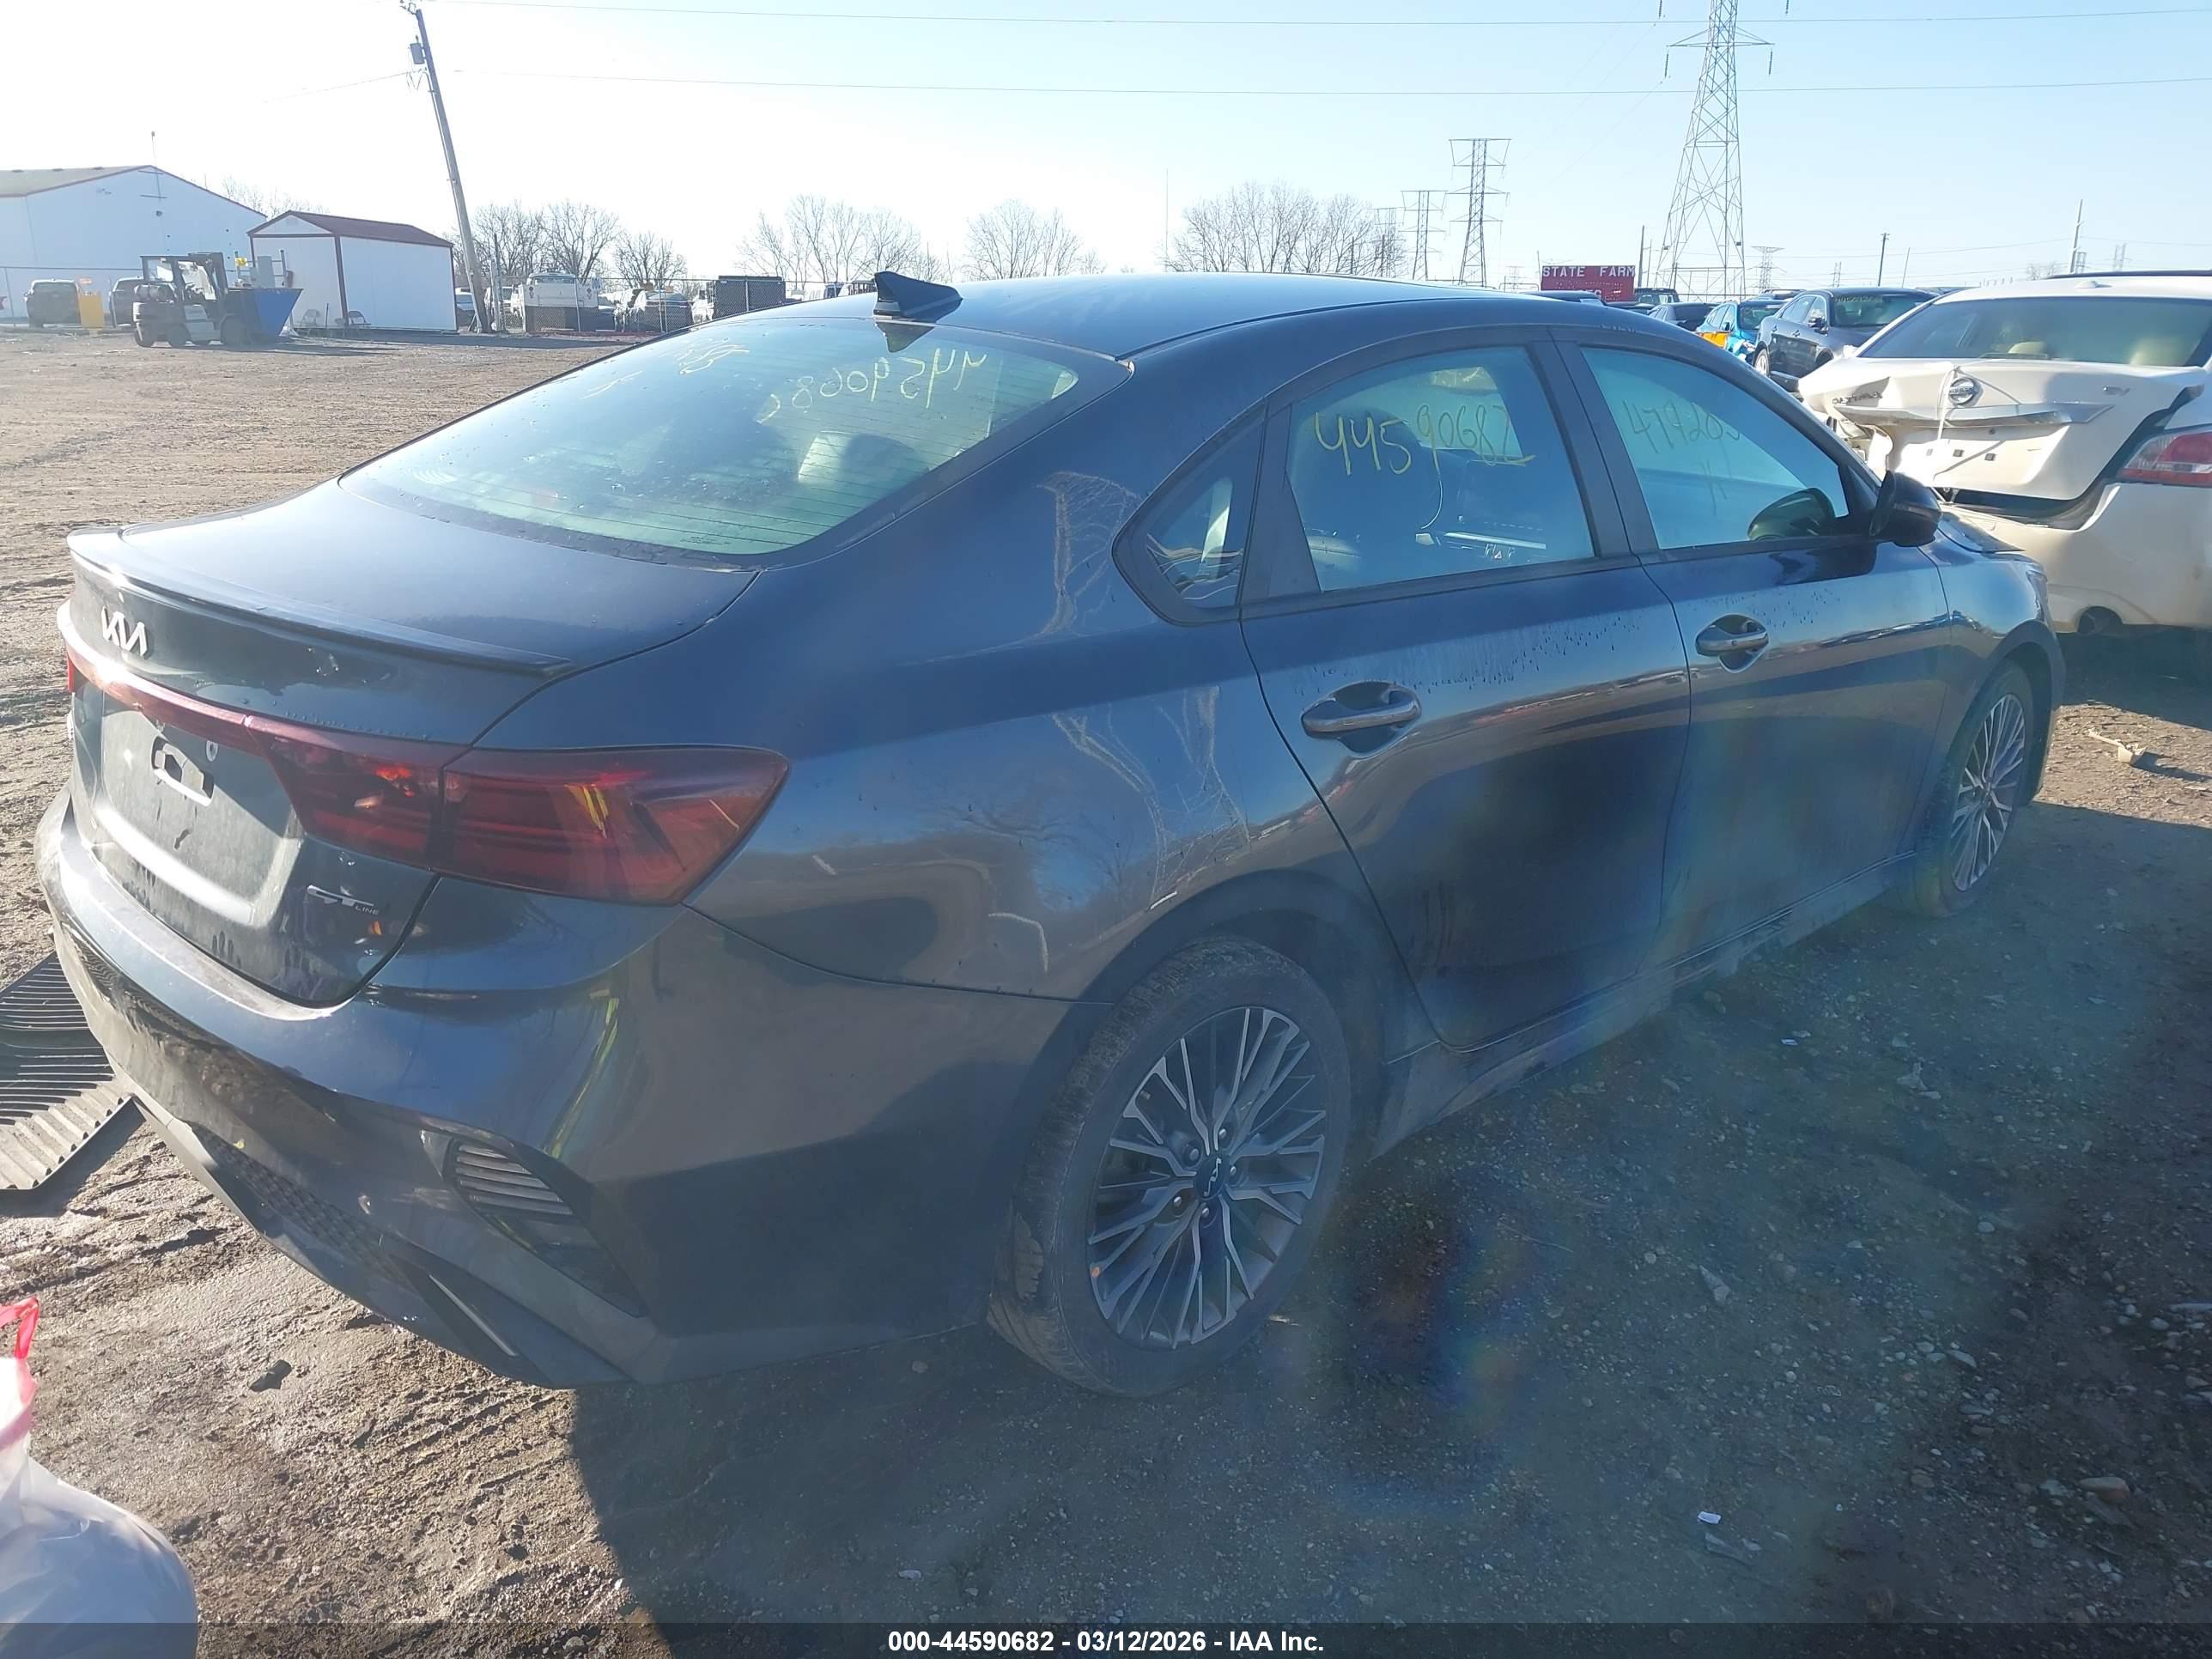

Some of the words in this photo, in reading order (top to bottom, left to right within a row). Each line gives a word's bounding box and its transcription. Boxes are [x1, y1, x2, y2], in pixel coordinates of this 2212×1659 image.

[1542, 266, 1585, 277] STATE
[1599, 266, 1635, 277] FARM
[100, 606, 148, 657] KIA
